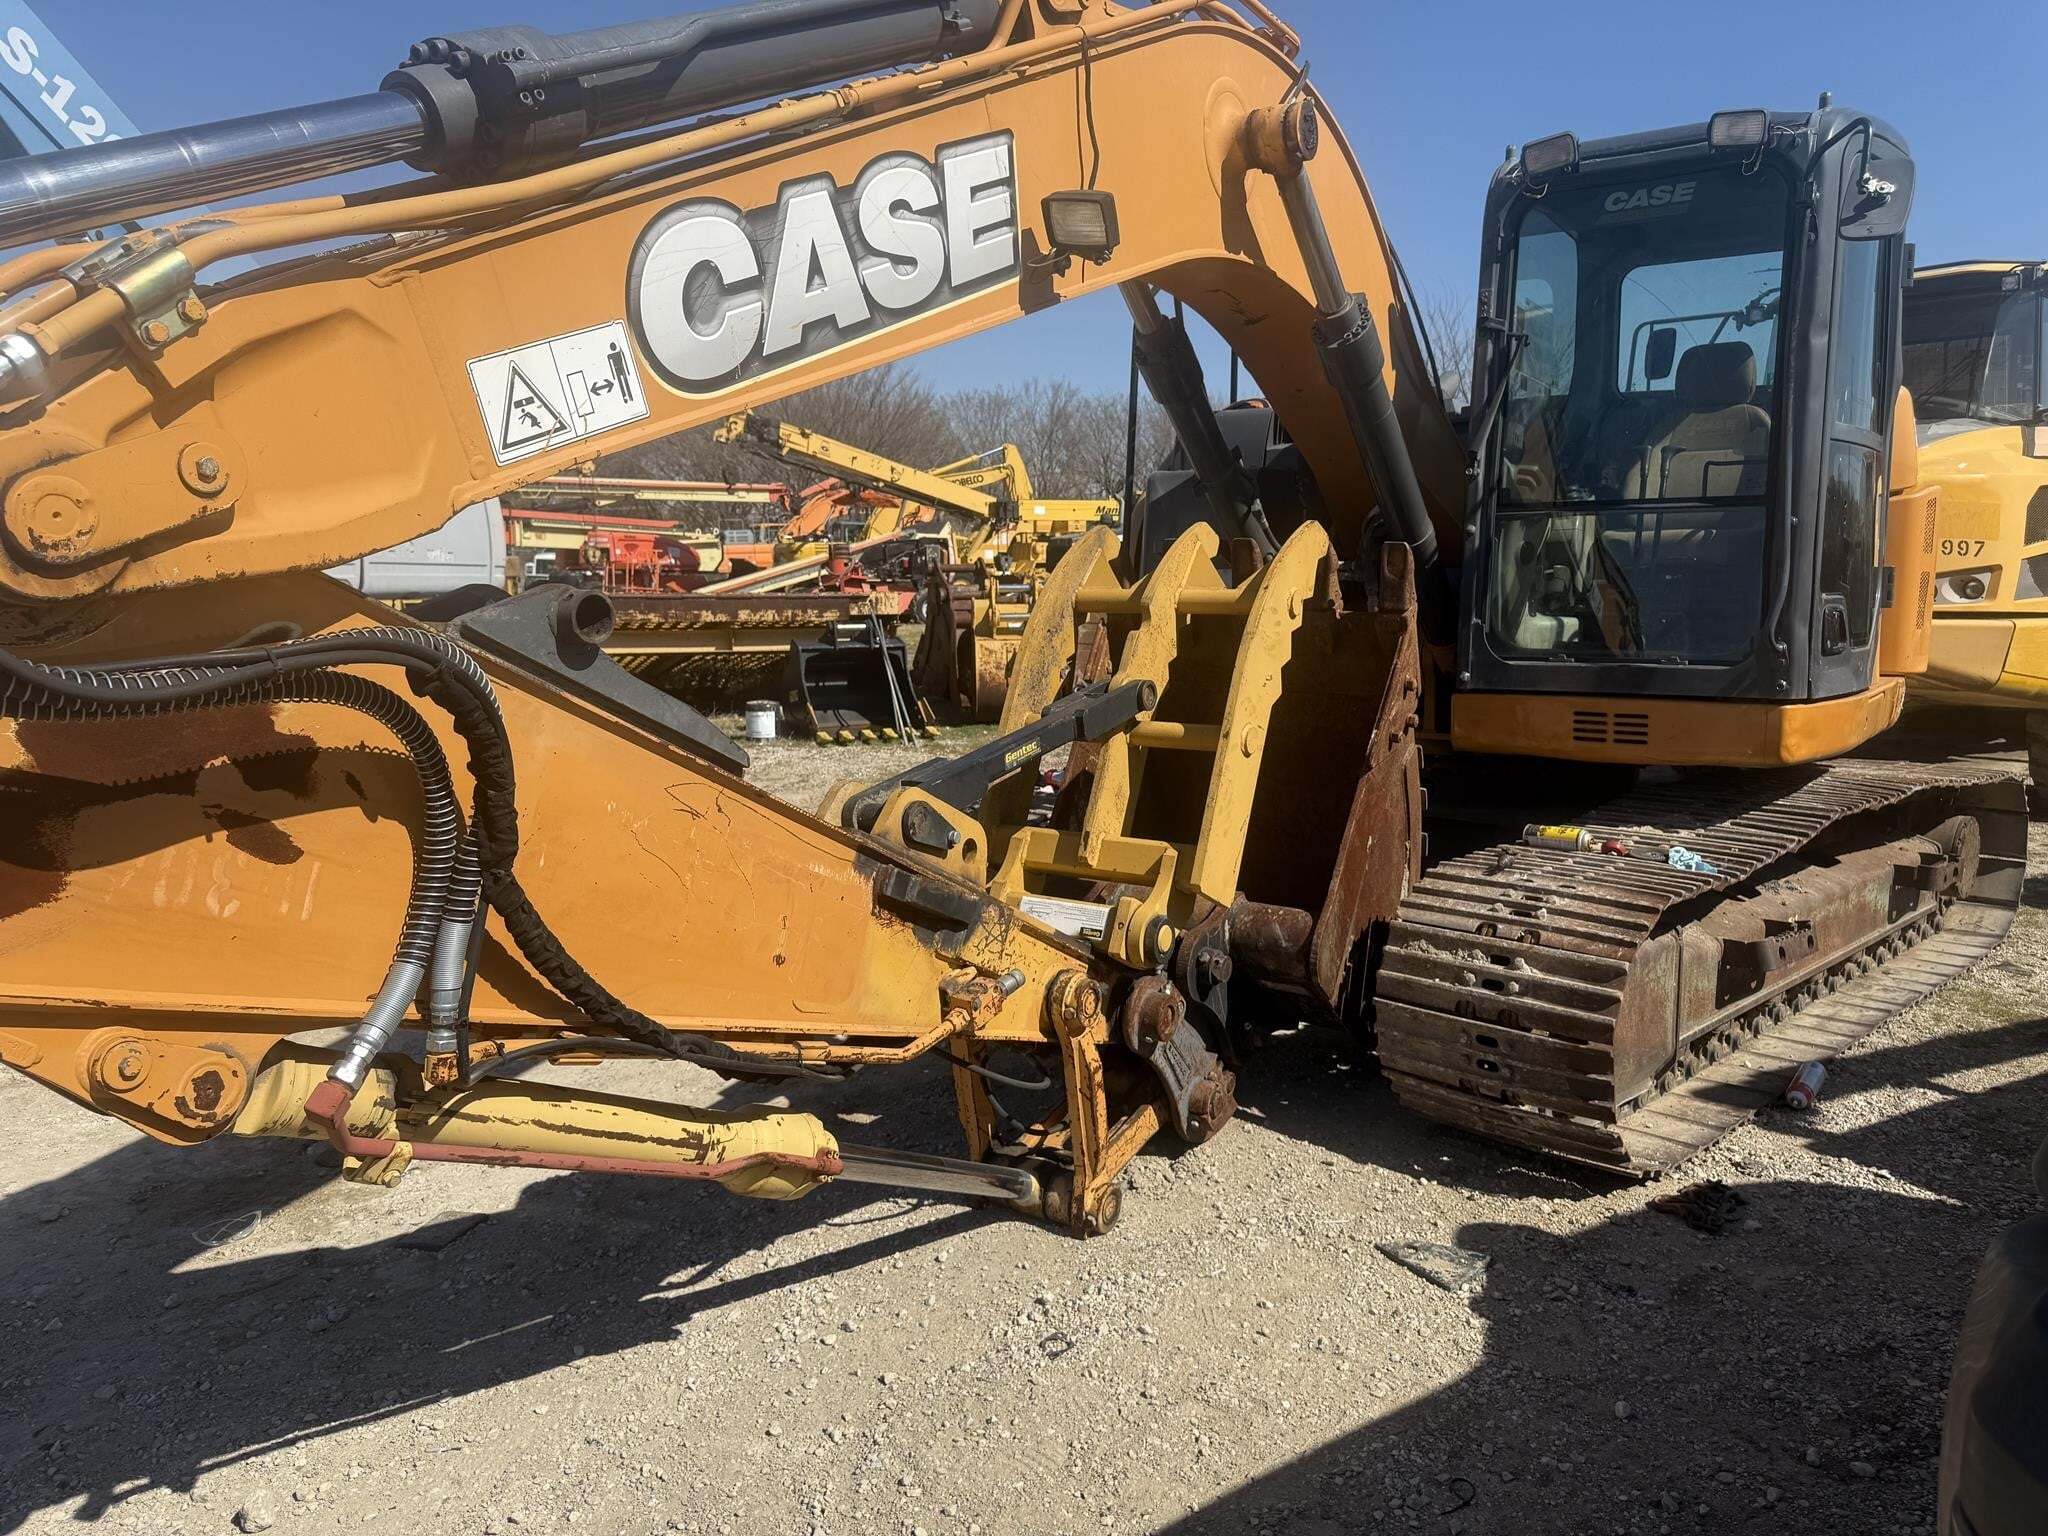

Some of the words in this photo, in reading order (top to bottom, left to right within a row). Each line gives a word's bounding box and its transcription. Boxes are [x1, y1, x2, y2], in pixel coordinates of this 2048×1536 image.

[0, 26, 121, 144] S-12
[1604, 181, 1697, 211] CASE
[638, 143, 1016, 382] CASE
[1941, 539, 1985, 557] 997
[1005, 741, 1038, 763] Gentec
